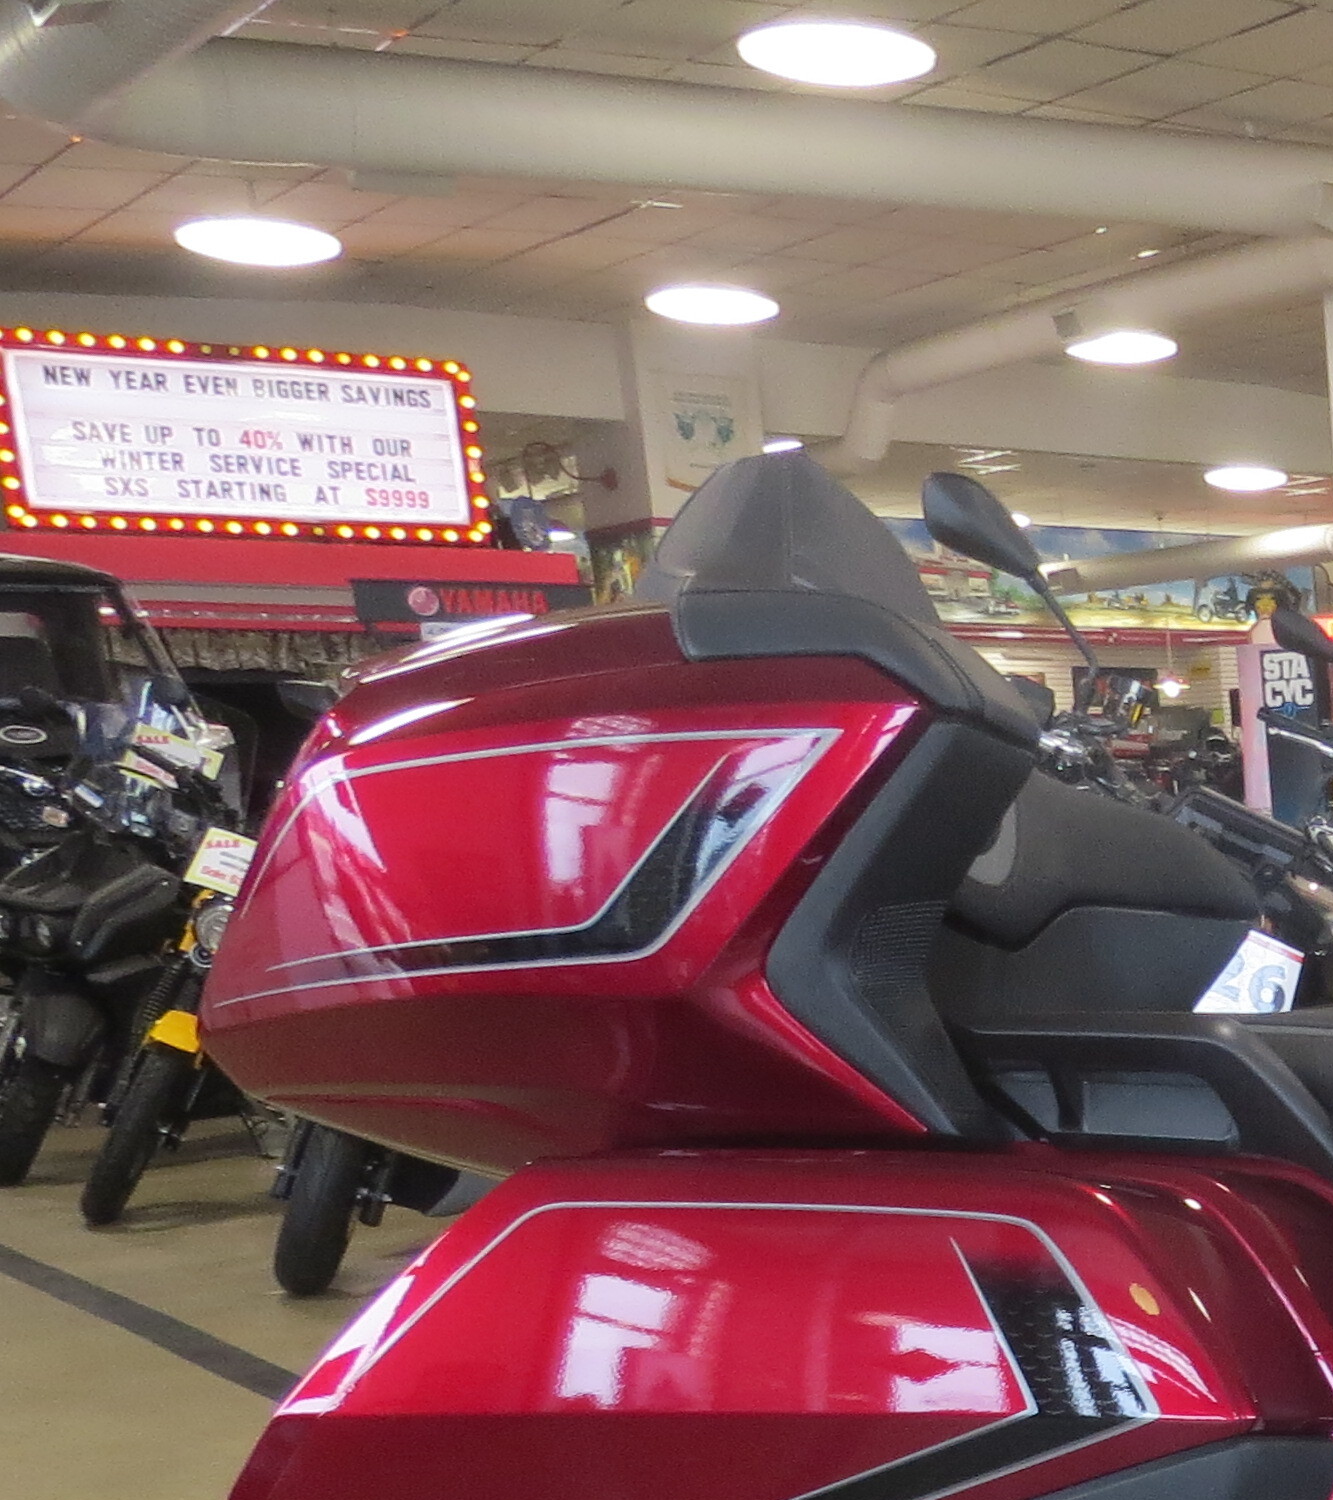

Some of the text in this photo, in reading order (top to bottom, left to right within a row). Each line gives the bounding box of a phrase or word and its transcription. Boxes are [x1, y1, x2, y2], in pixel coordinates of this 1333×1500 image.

[42, 365, 432, 409] NEW YEAR EVEN BIGGER SAVINGS
[72, 420, 412, 458] SAVE UP TO 40% WITH OUR
[101, 450, 416, 484] WINTER SERVICE SPECIAL
[103, 476, 150, 498] SXS
[177, 479, 287, 503] STARTING
[314, 486, 341, 505] AT
[440, 587, 548, 614] YAMAHA
[1263, 651, 1310, 681] STA
[1265, 678, 1315, 708] CYC
